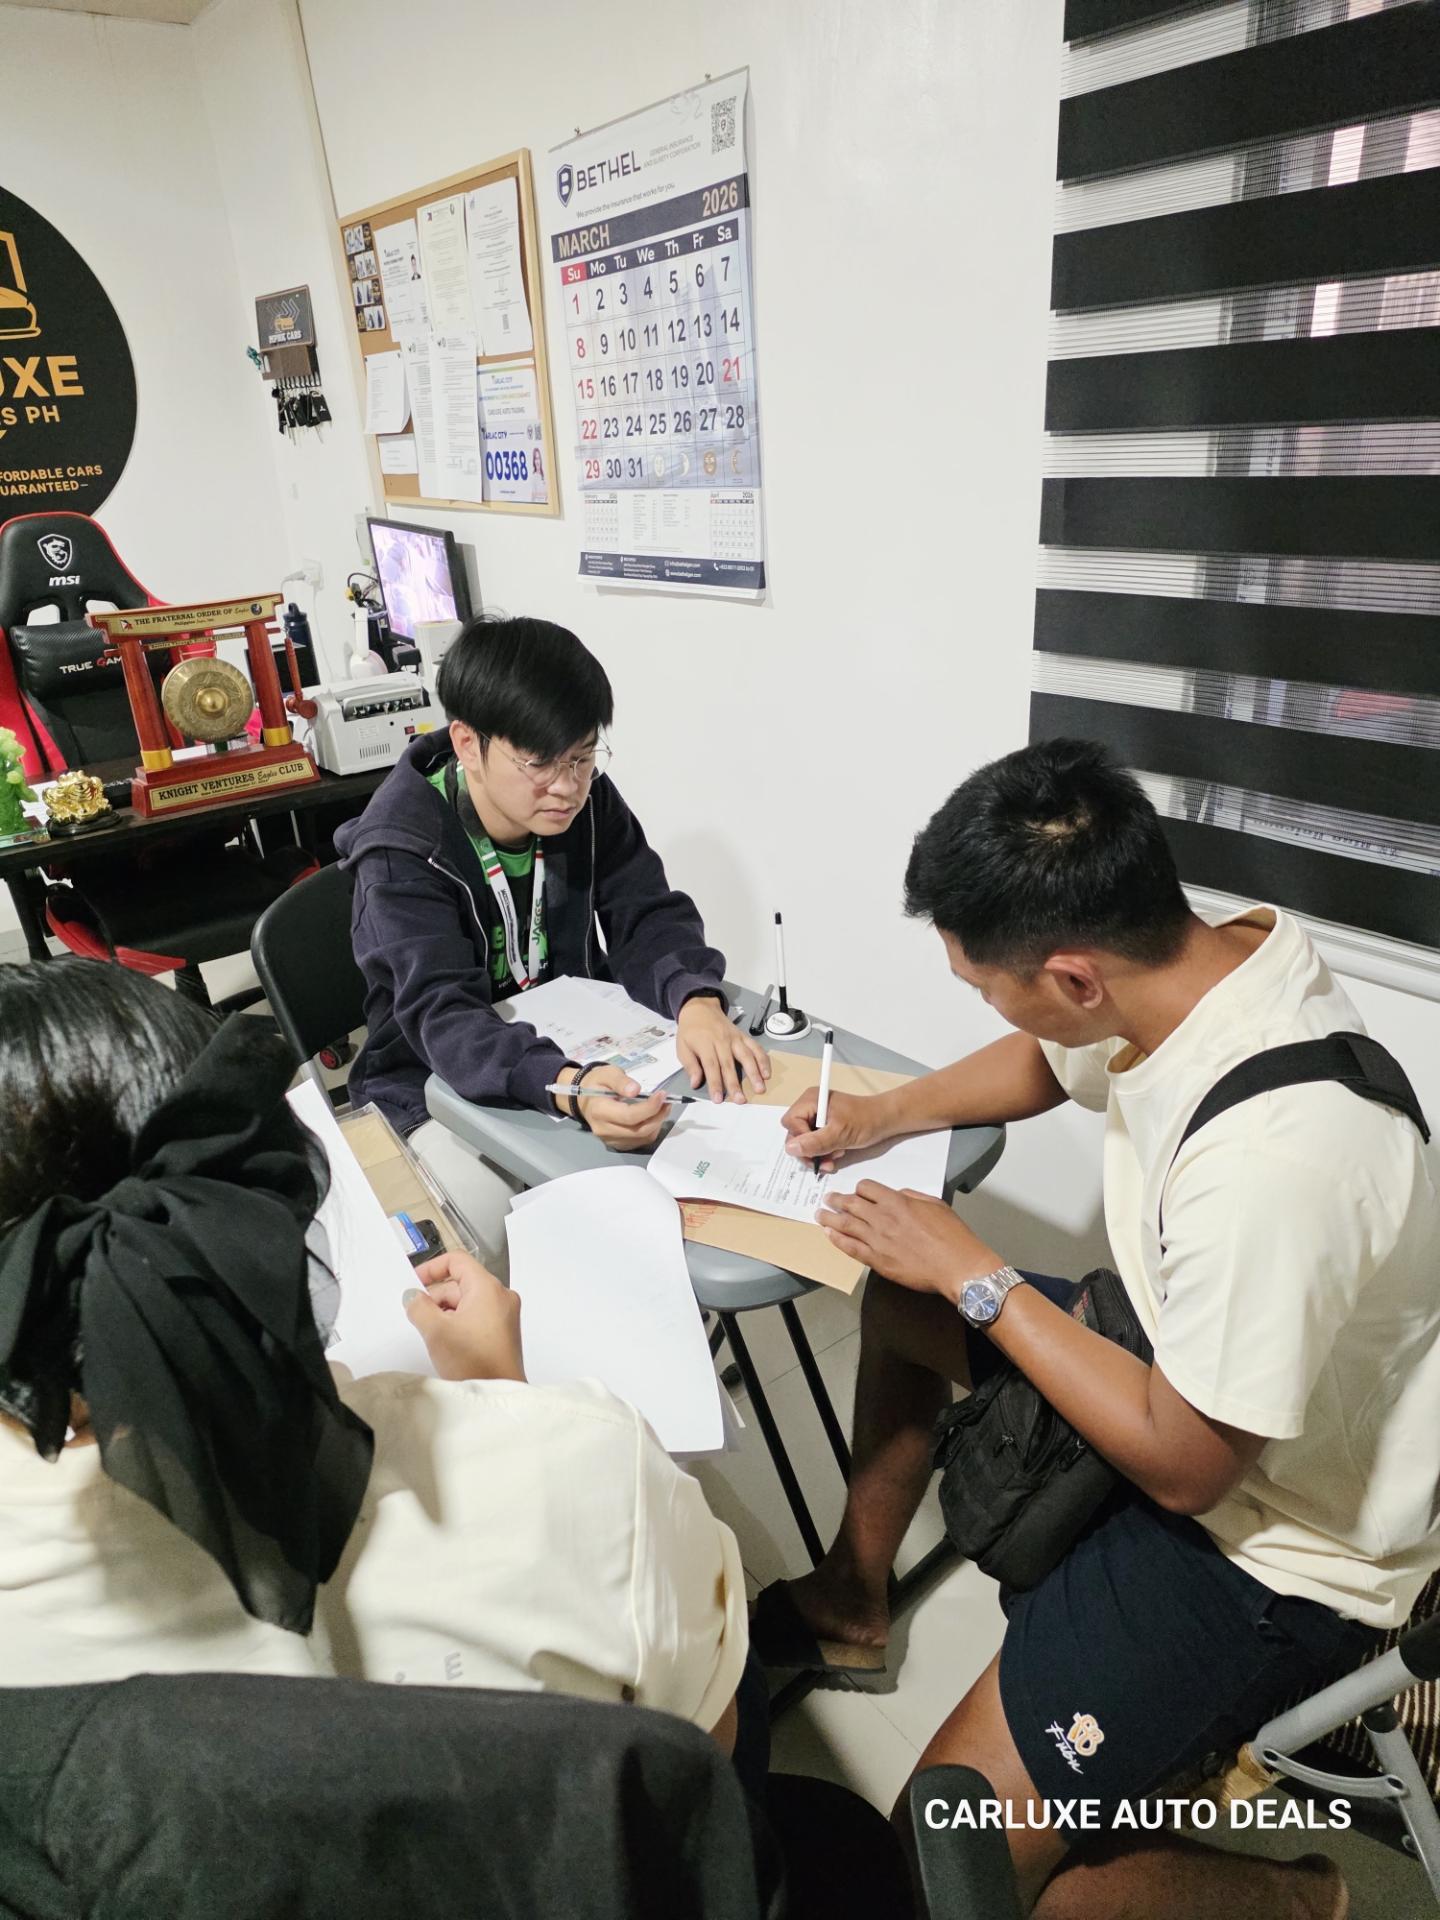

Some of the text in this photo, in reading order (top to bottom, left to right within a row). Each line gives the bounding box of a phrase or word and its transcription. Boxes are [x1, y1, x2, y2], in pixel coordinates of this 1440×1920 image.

[577, 151, 641, 191] BETHEL
[702, 181, 738, 217] 2026
[558, 224, 610, 259] MARCH
[568, 226, 732, 281] Su Mo Tu We Th Fr Sa
[573, 256, 730, 315] 1 2 3 4 5 6 7
[576, 307, 740, 358] 8 9 10 11 12 13 14
[578, 356, 740, 399] 15 16 17 18 19 20 21
[25, 405, 60, 424] PH
[582, 405, 744, 440] 22 23 24 25 26 27 28
[66, 464, 103, 477] CARS
[486, 450, 528, 481] 00368
[585, 457, 643, 479] 29 30 31
[49, 574, 80, 586] msi
[135, 617, 151, 627] THE
[153, 612, 195, 625] FRATERNAL
[197, 609, 222, 620] ORDER
[223, 607, 233, 617] OF
[60, 661, 93, 675] TRUE
[158, 783, 199, 801] KNIGHT
[201, 773, 255, 792] VENTURES
[257, 768, 279, 784] Eagles
[279, 762, 304, 776] CLUB
